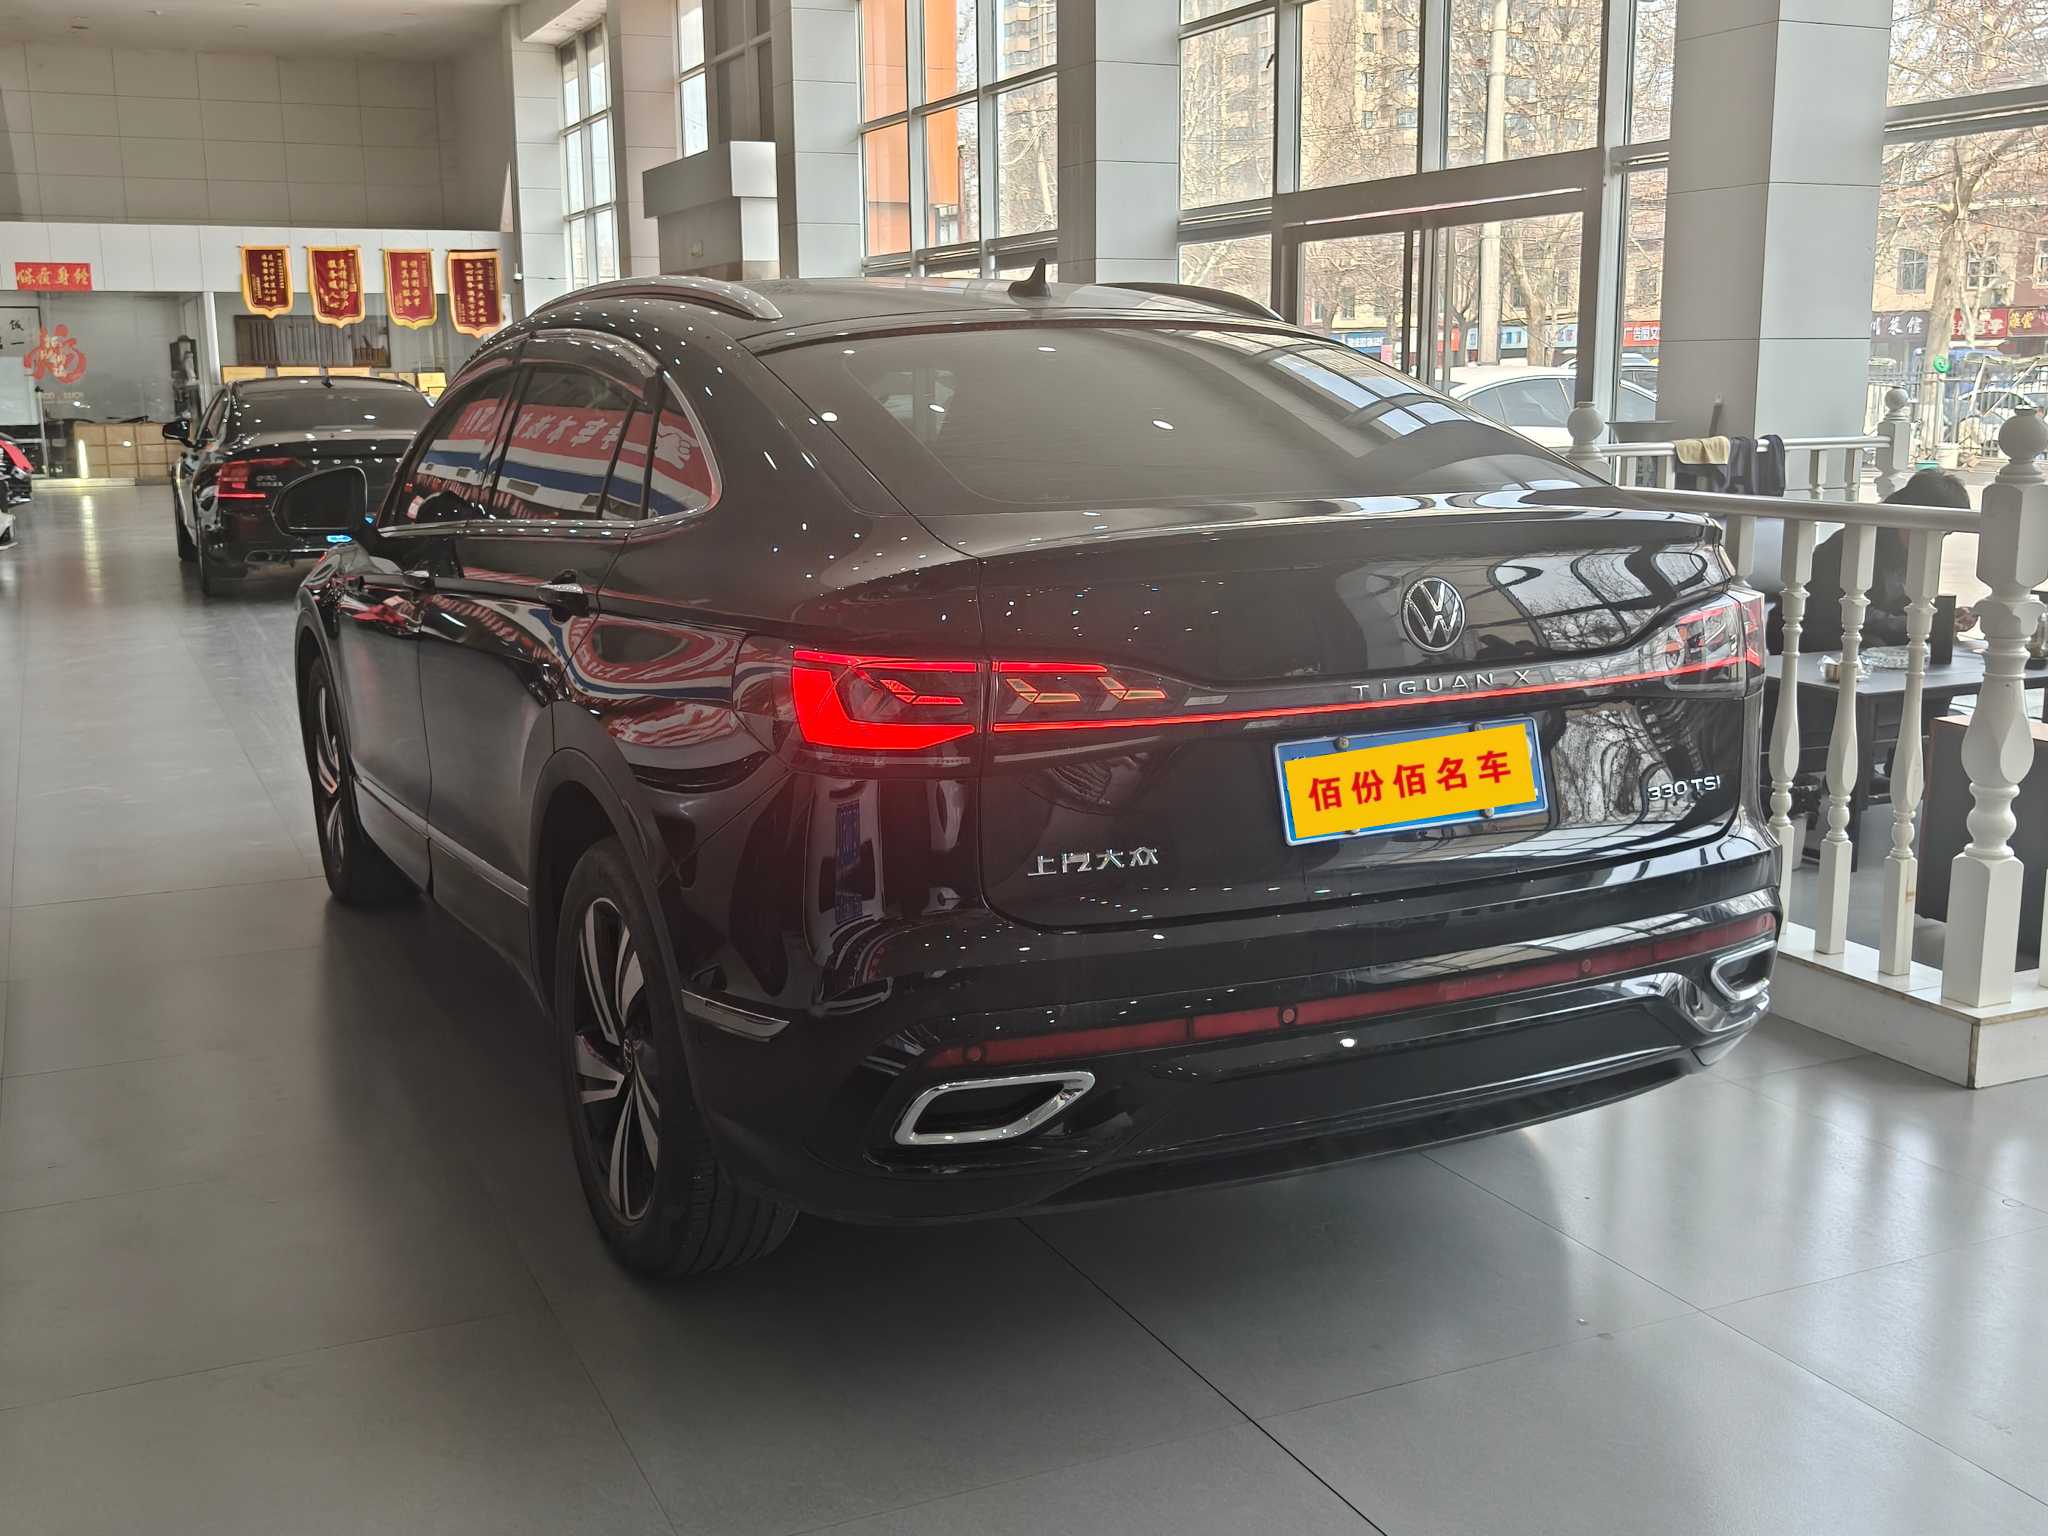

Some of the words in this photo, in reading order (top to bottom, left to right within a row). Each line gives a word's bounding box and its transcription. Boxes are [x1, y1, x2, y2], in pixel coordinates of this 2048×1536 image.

[1352, 673, 1493, 697] TIGUAN
[1514, 669, 1530, 684] X
[1648, 780, 1688, 801] 330
[1690, 775, 1720, 791] TSI
[1027, 846, 1159, 876] 上汽大众
